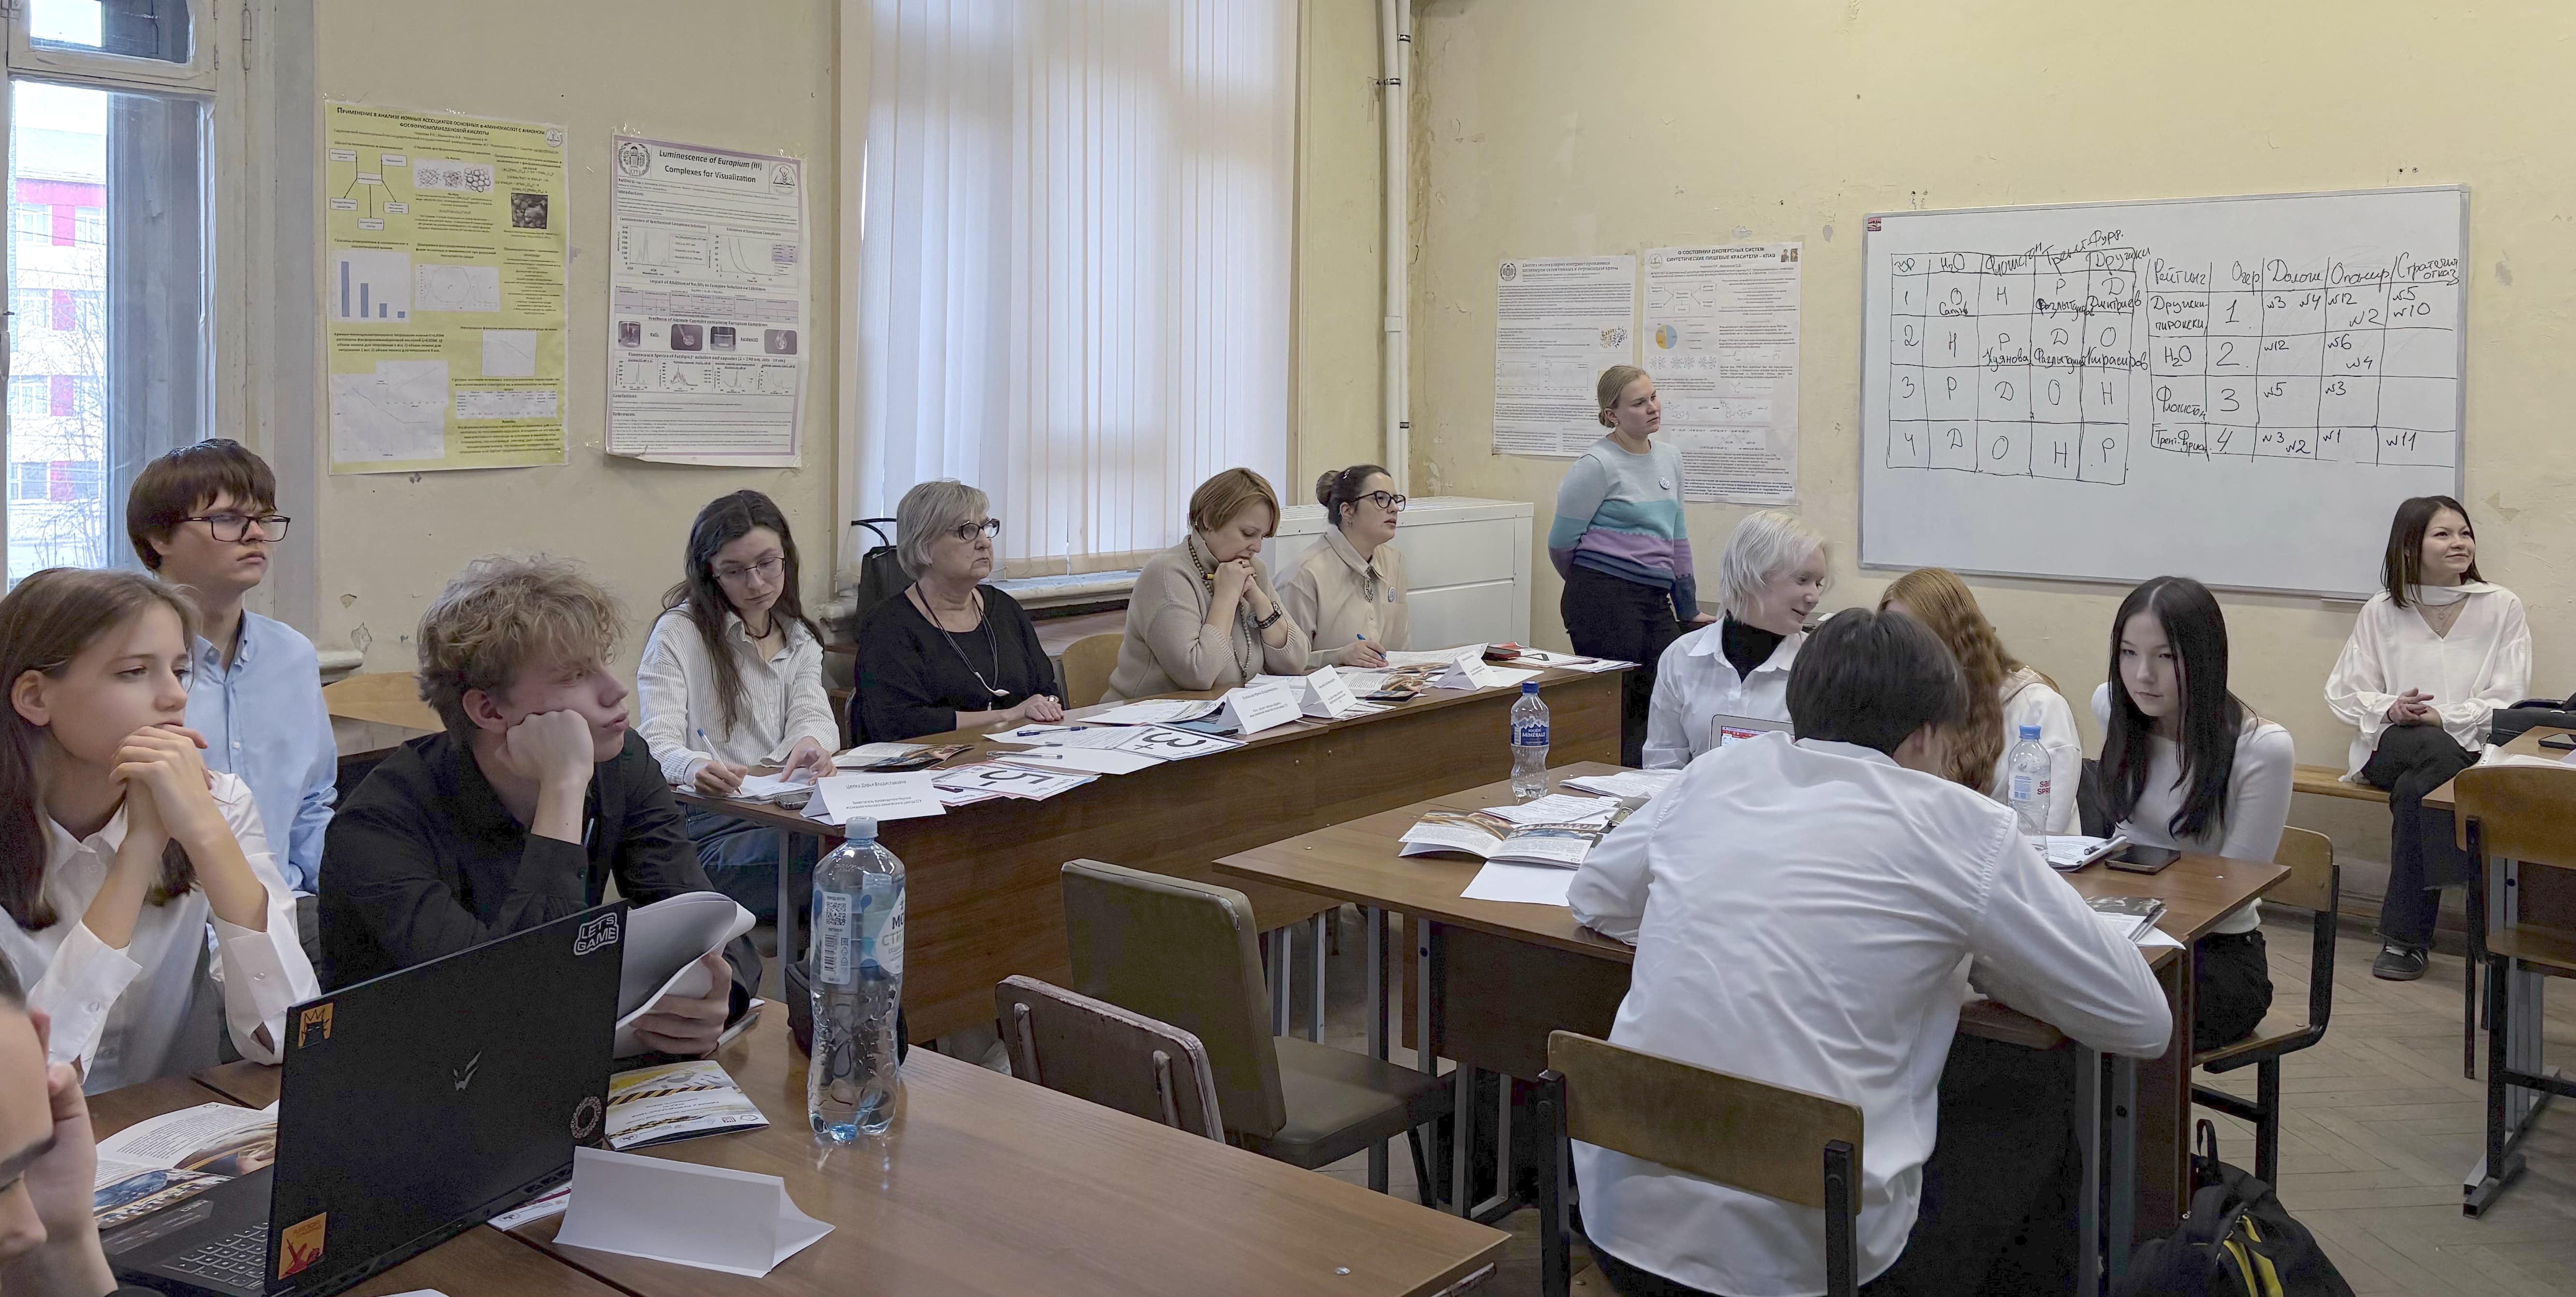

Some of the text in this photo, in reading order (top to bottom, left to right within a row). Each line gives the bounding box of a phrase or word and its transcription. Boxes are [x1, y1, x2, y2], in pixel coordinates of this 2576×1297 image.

[659, 149, 707, 163] Luminescence
[718, 158, 749, 168] Europium
[751, 161, 762, 170] (III)
[665, 165, 701, 176] Complexes
[715, 172, 756, 183] Visualization
[2155, 258, 2206, 285] Рейтинг
[2225, 299, 2240, 324] 1
[1904, 325, 1919, 346] 2
[1902, 376, 1915, 398] 3
[2220, 388, 2240, 412] 3
[2218, 428, 2233, 451] 4
[577, 927, 616, 951] GAME
